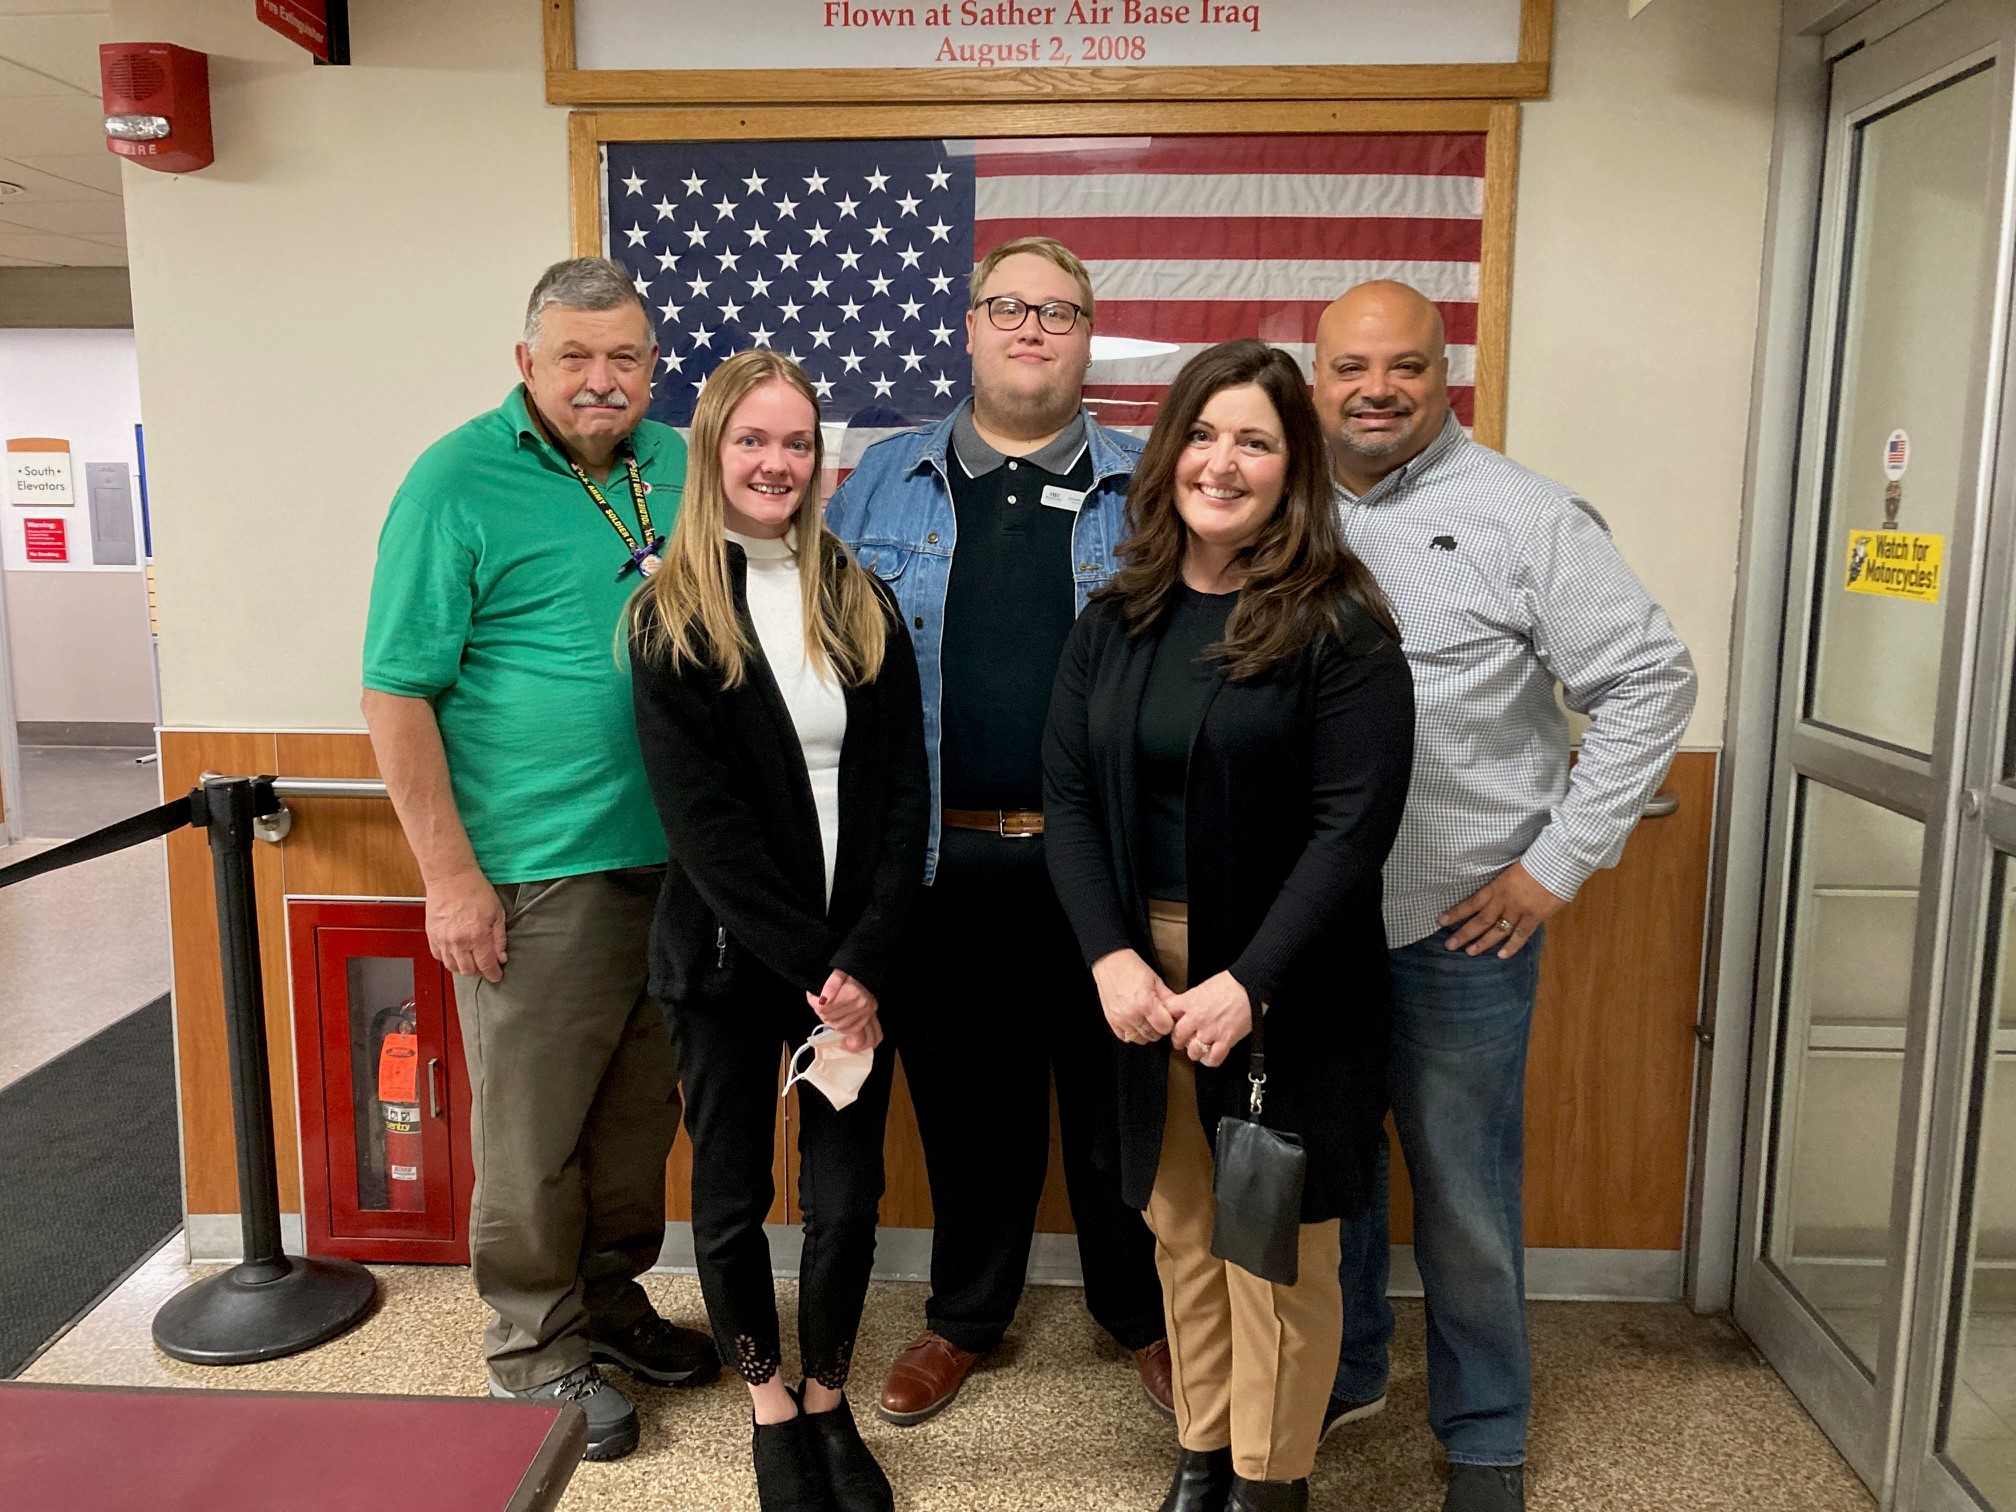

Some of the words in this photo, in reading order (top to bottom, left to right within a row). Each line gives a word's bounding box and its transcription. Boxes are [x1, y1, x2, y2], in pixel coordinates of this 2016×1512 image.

[823, 1, 916, 27] Flown
[925, 3, 951, 26] at
[961, 0, 1056, 26] Sather
[1064, 0, 1113, 25] Air
[1123, 0, 1190, 24] Base
[1200, 0, 1260, 32] Iraq
[935, 36, 1041, 68] August
[1049, 36, 1072, 65] 2,
[1081, 36, 1147, 61] 2008
[24, 465, 55, 476] South
[629, 467, 640, 482] LIFE
[17, 480, 65, 491] Elevators
[633, 482, 643, 497] FOR
[588, 485, 606, 505] ARMY
[605, 508, 630, 538] SOLDIER
[636, 498, 650, 526] SOLDIER
[1876, 534, 1908, 560] Watch
[1912, 537, 1930, 562] for
[1865, 558, 1938, 591] Motorcycles!
